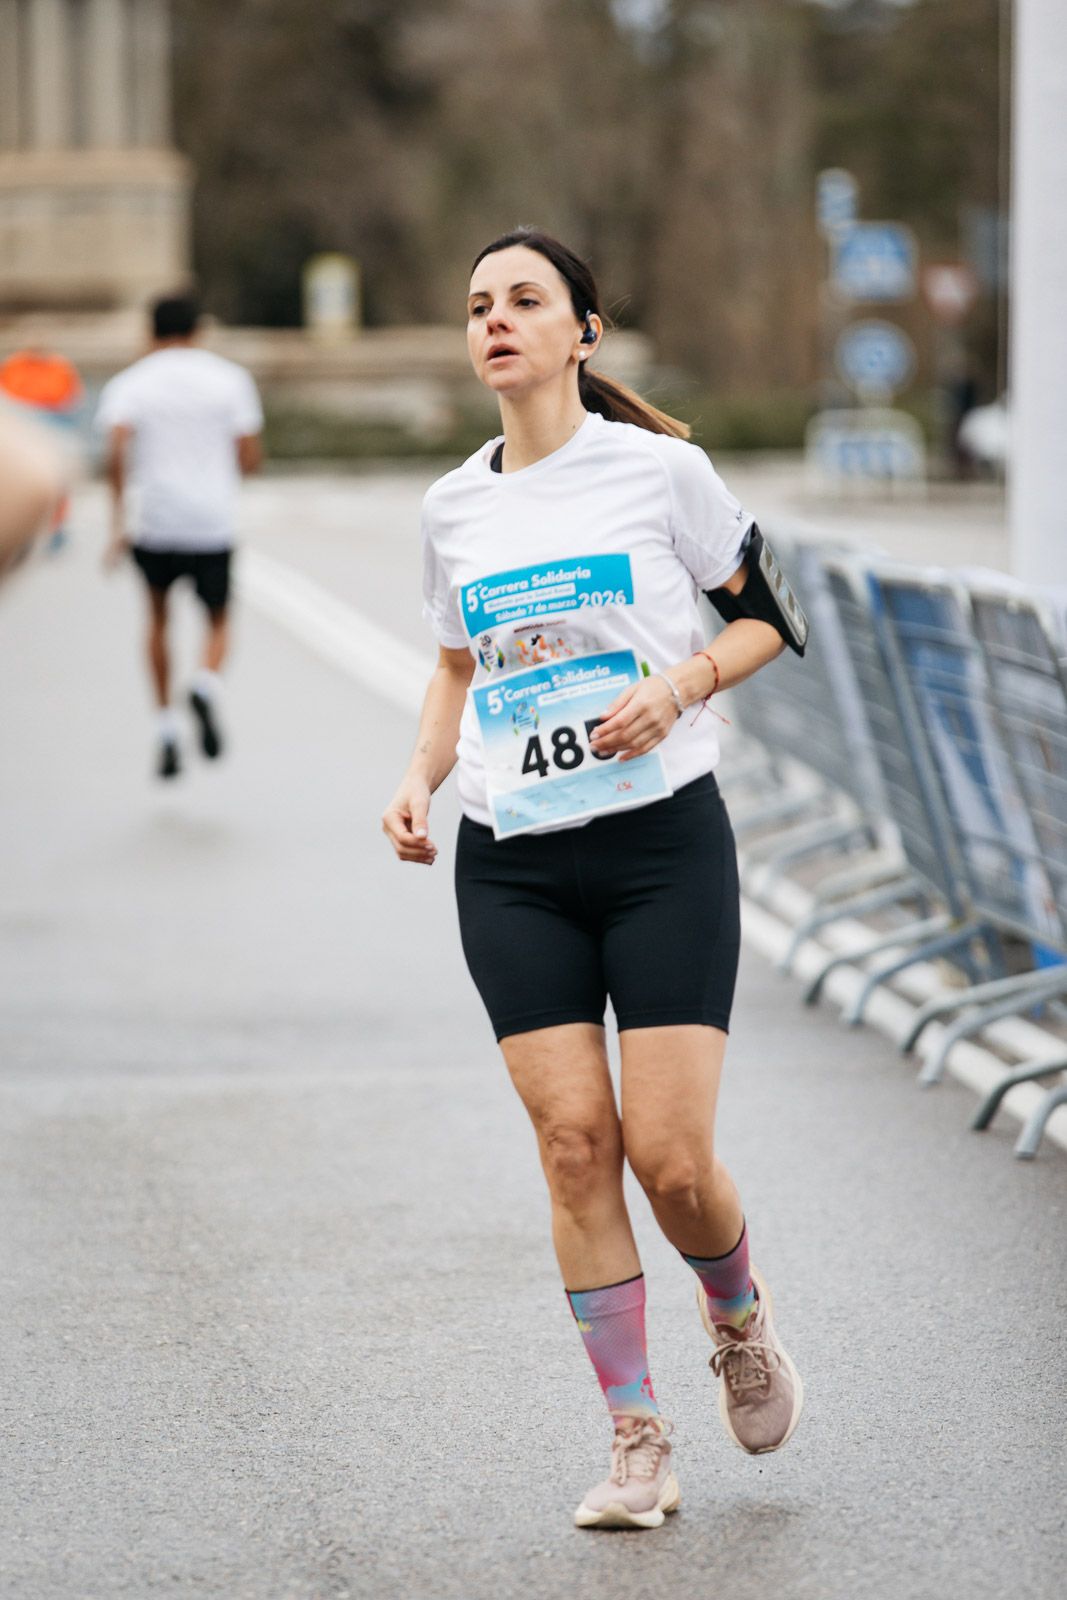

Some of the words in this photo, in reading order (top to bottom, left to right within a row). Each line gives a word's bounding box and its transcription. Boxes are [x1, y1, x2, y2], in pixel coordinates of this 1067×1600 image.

[479, 580, 529, 600] Carrera
[527, 603, 535, 615] 7
[534, 602, 547, 613] de
[548, 599, 577, 611] marzo
[578, 590, 627, 609] 2026
[504, 681, 551, 703] Carrera
